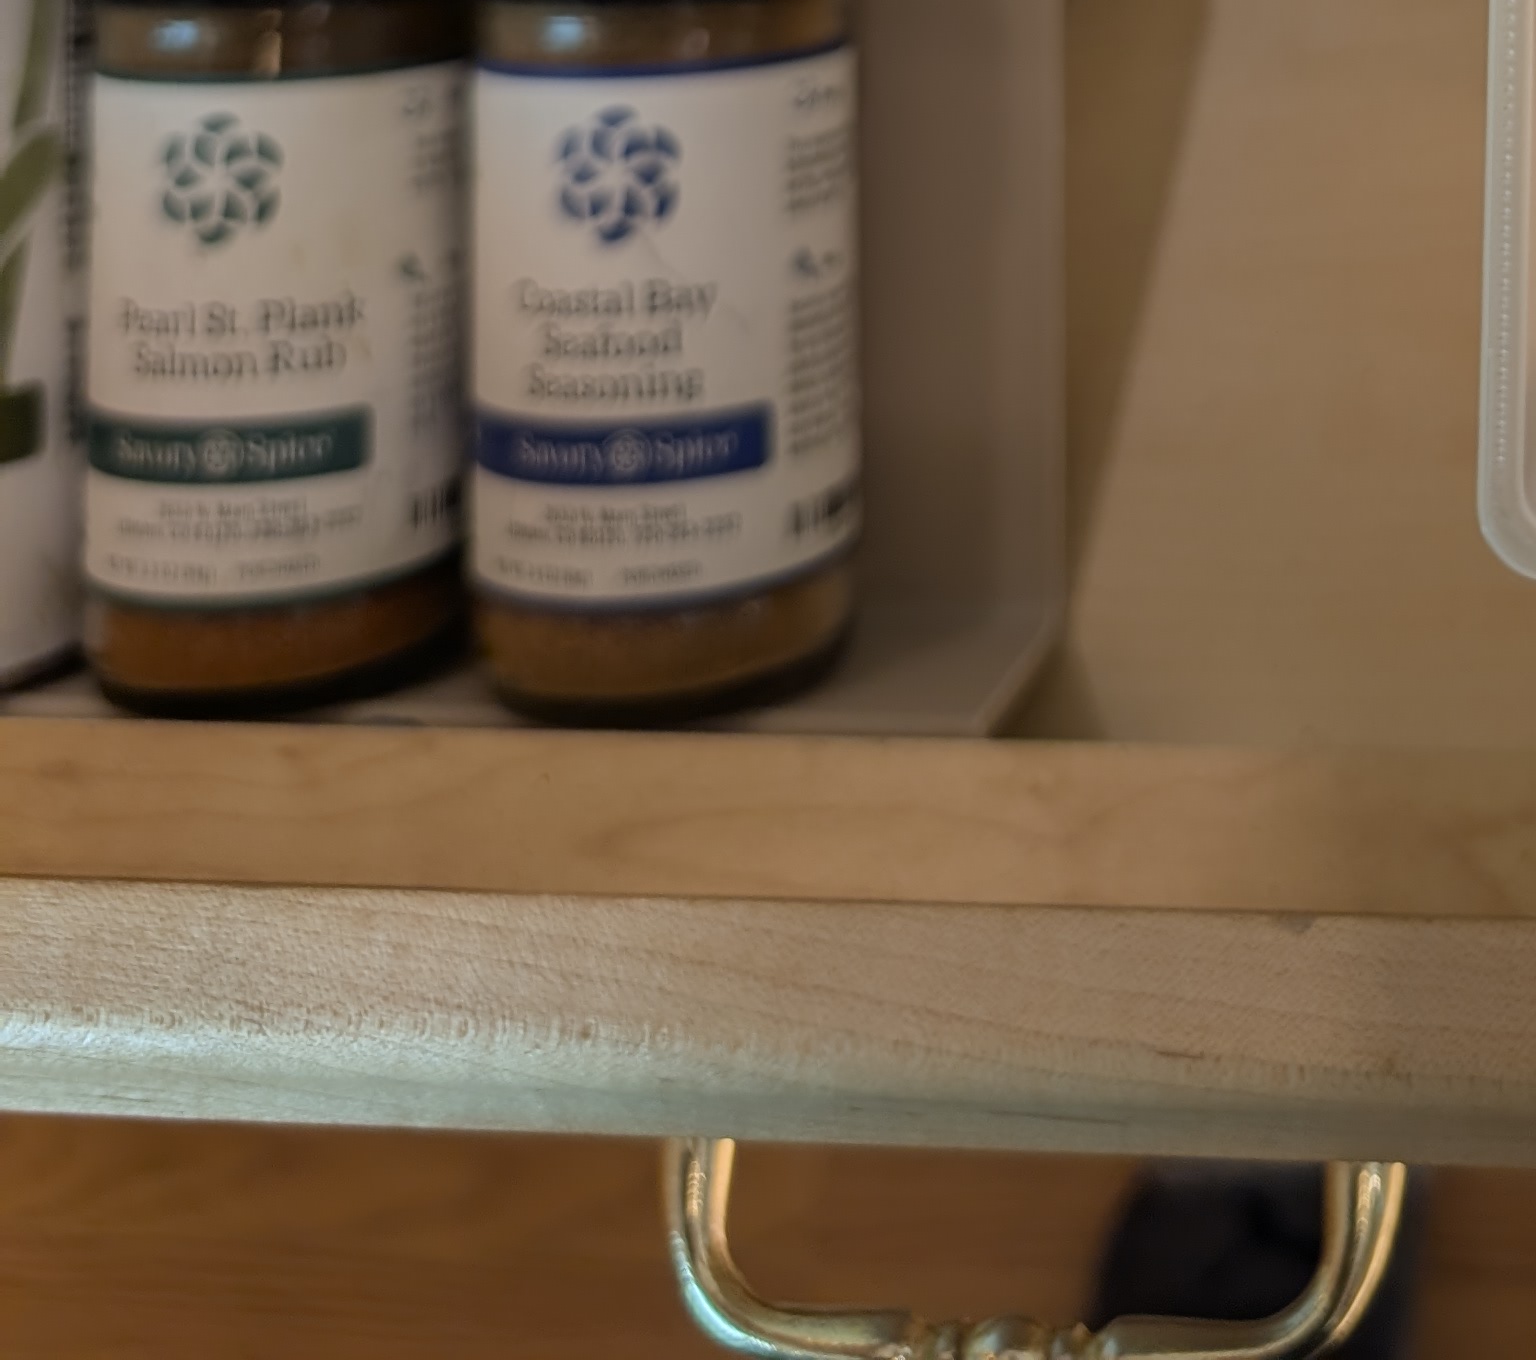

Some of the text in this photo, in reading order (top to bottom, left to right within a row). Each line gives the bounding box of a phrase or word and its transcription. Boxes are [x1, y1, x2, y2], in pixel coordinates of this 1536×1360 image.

[119, 296, 197, 335] Pearl
[256, 290, 367, 332] Plank
[519, 280, 718, 321] Coastal Bay
[132, 334, 348, 377] Salmon Rub
